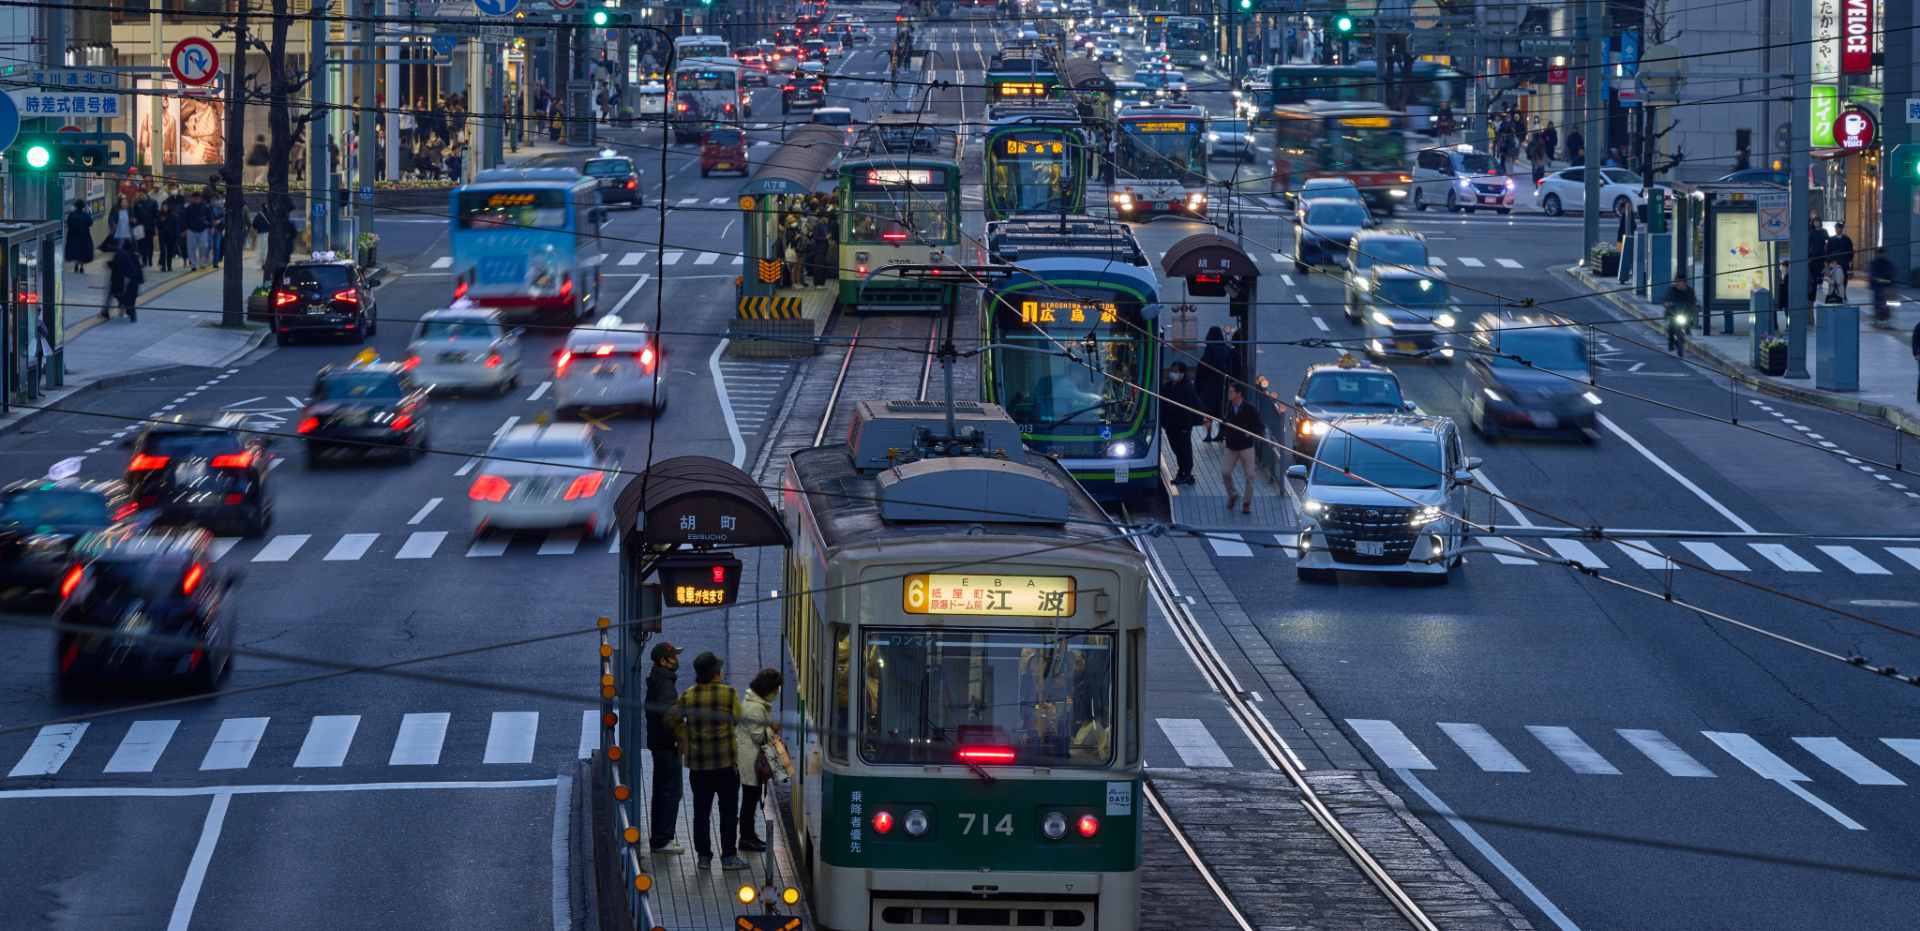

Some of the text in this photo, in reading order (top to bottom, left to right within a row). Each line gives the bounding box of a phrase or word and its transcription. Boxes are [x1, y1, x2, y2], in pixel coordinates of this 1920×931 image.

[26, 96, 117, 113] 時差式信号機
[1040, 308, 1117, 322] 広島駅
[680, 514, 737, 530] 胡町
[677, 586, 724, 603] 電車がきます
[908, 580, 924, 608] 6
[932, 588, 985, 599] 紙屋町
[986, 589, 1065, 611] 江波
[958, 812, 1014, 836] 714
